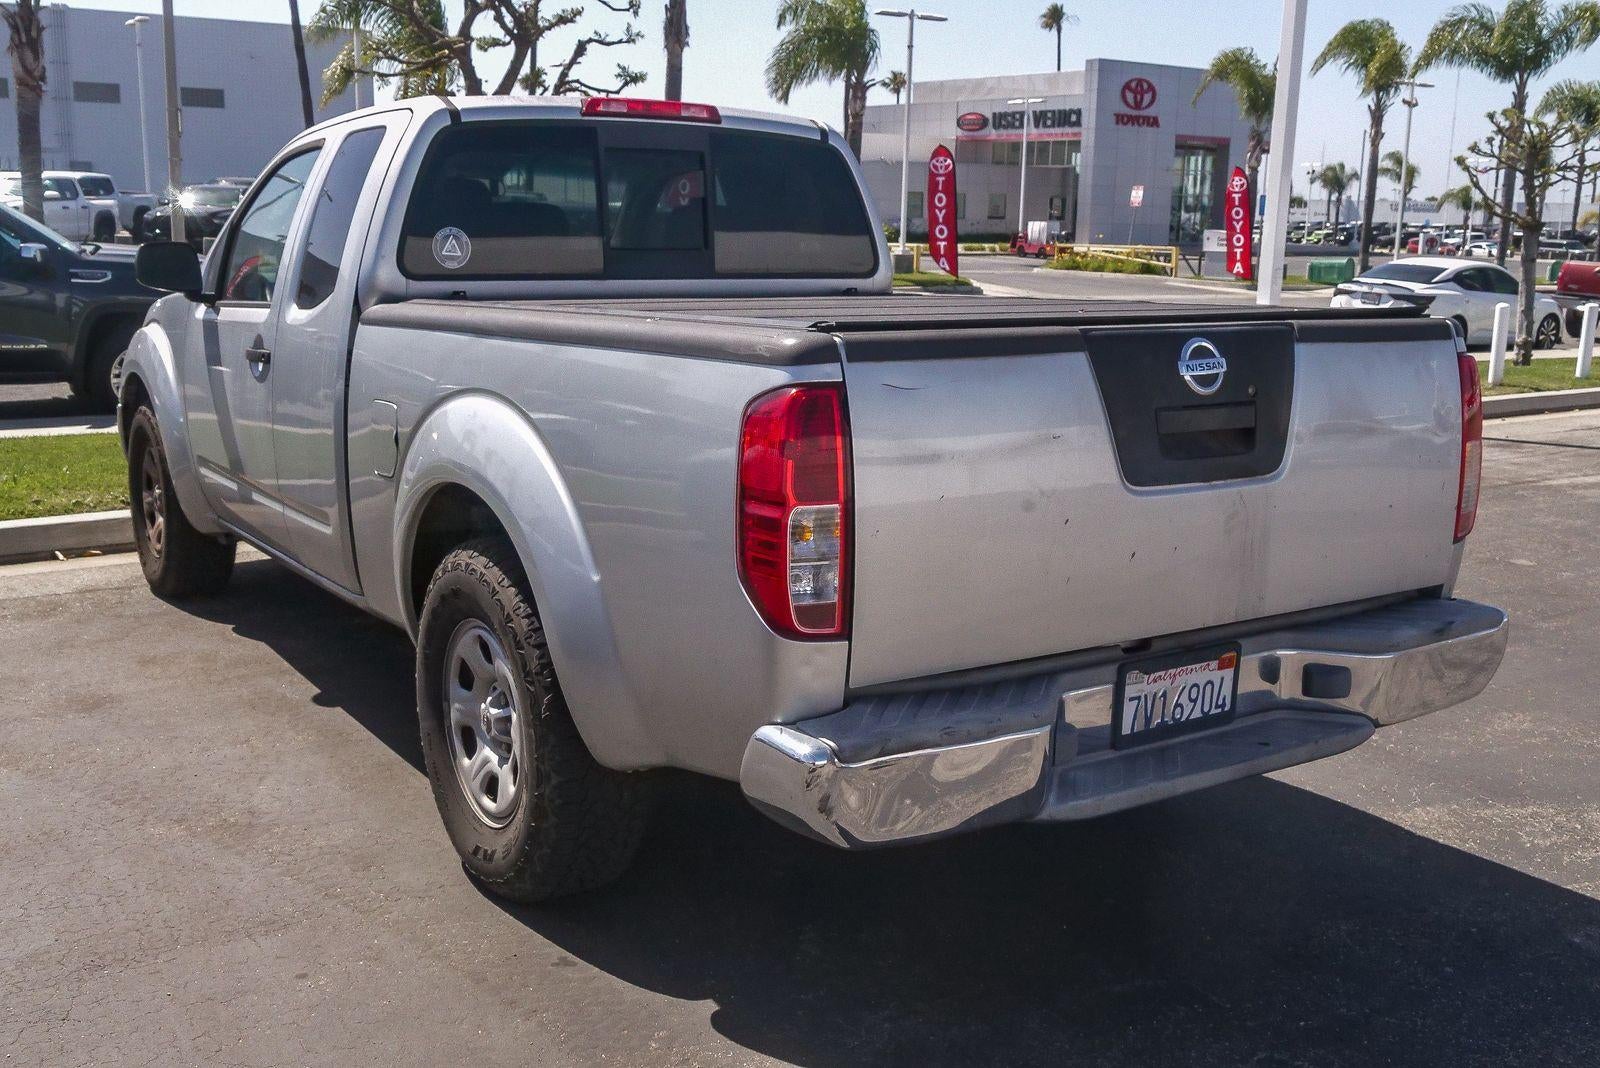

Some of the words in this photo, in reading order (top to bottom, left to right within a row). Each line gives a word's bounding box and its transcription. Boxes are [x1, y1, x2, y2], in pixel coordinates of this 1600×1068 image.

[1113, 113, 1160, 128] TOYOTA
[934, 177, 950, 271] TOYOTA
[1231, 193, 1244, 274] TOYOTA
[1185, 361, 1224, 373] NISSAN
[1146, 661, 1216, 686] California
[1128, 676, 1226, 735] 7V16904
